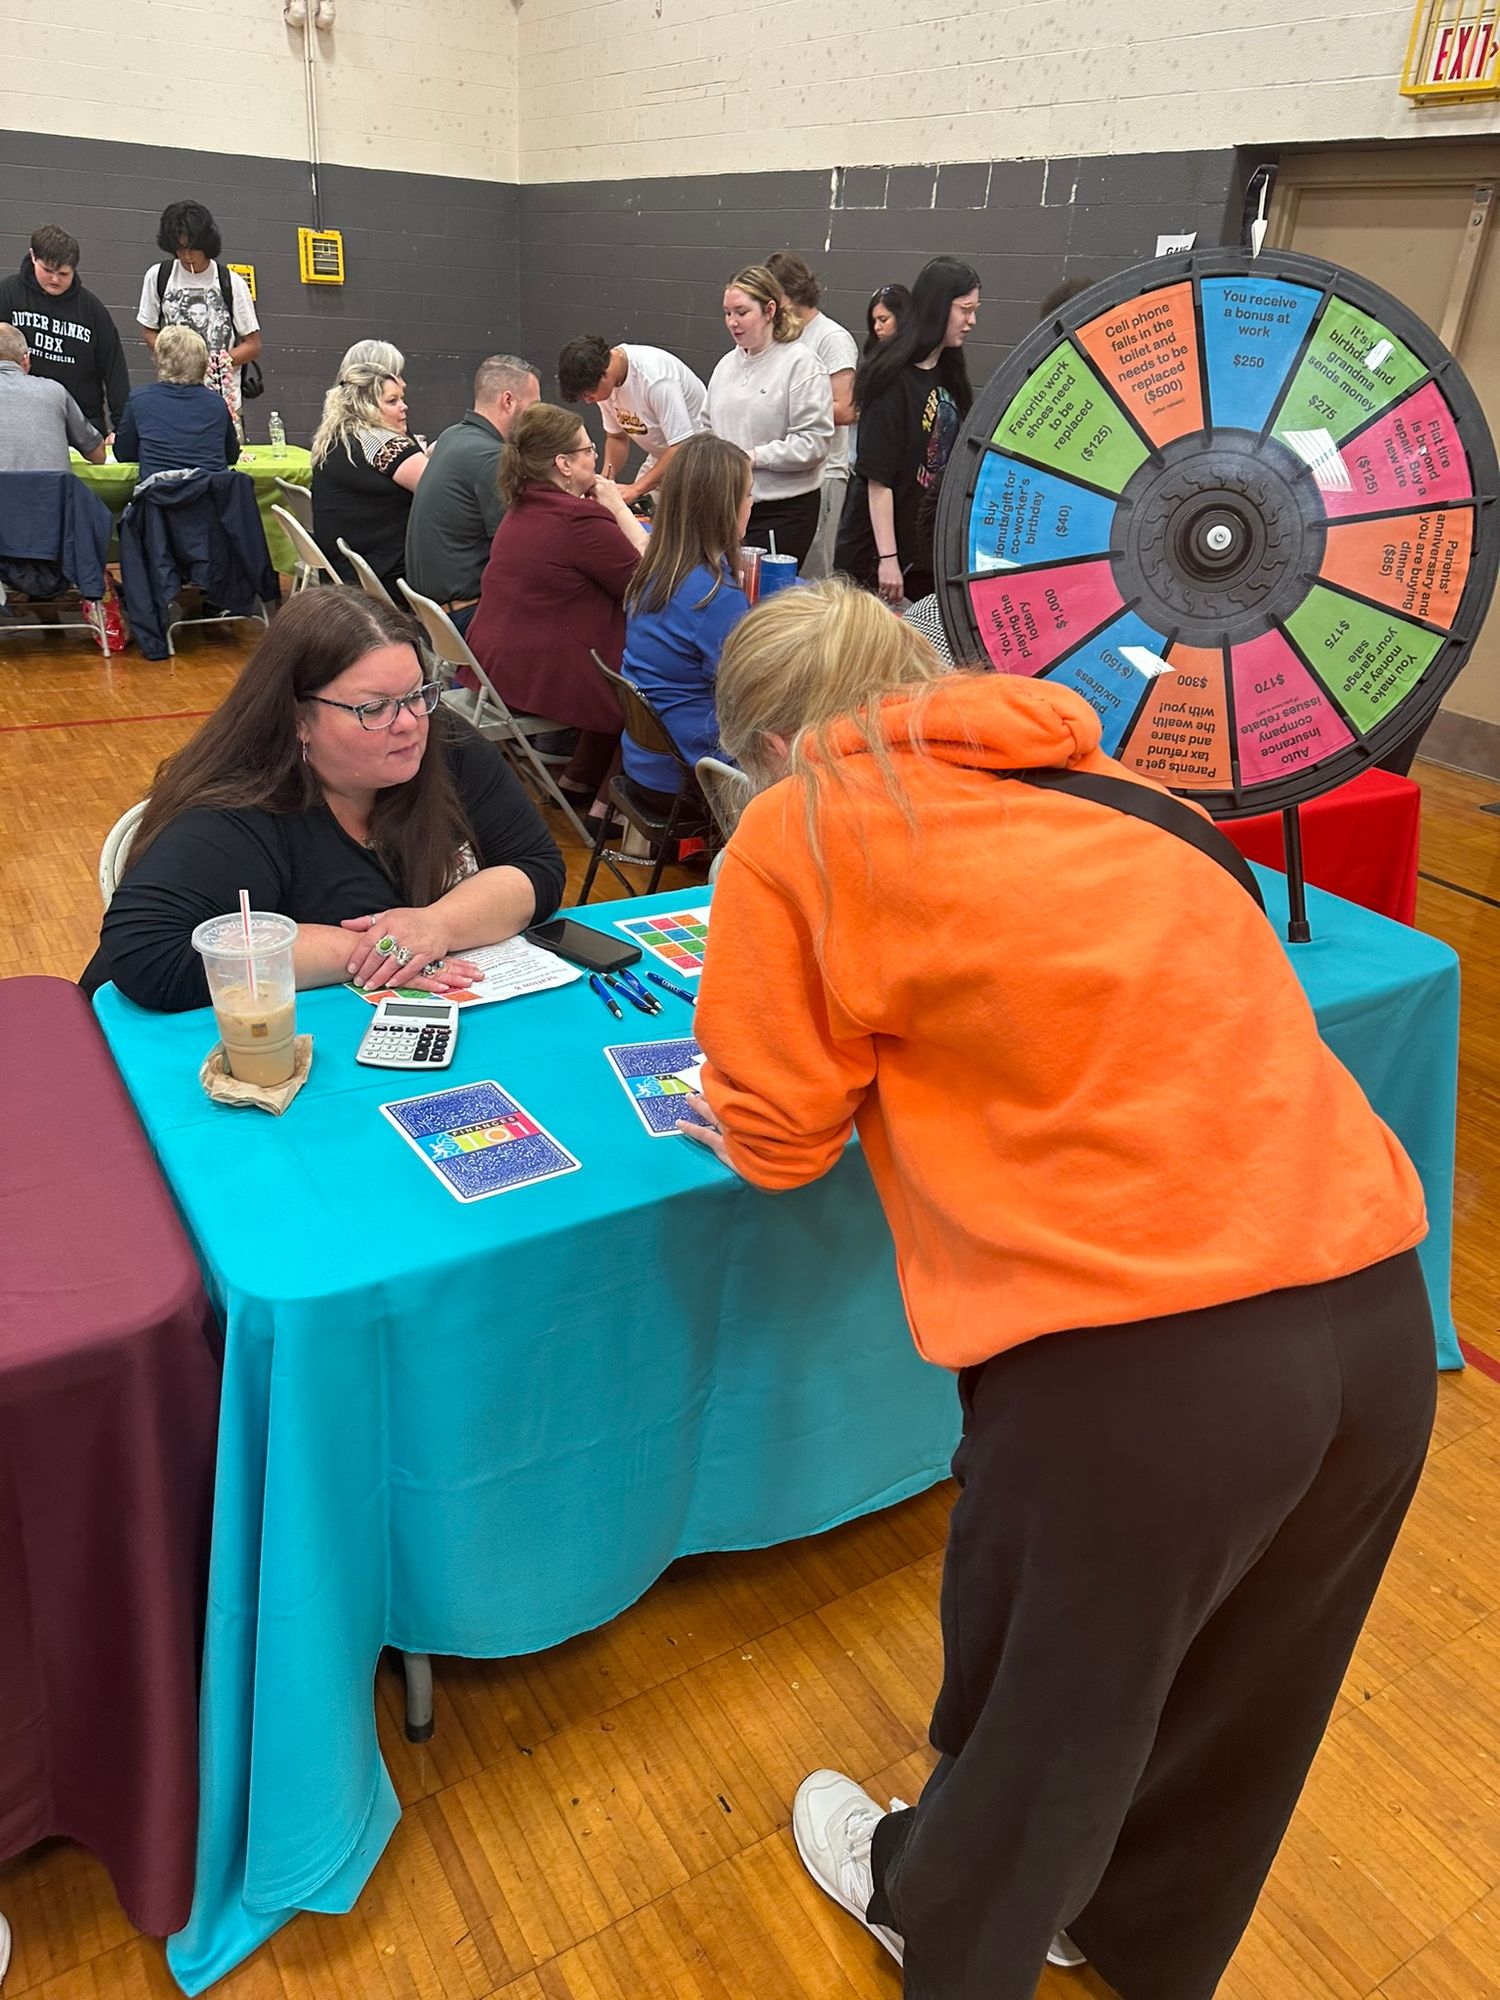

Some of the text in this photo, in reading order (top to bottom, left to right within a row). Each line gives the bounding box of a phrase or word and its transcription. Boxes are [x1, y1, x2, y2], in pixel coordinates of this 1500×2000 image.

[1433, 23, 1493, 81] EXIT
[1223, 290, 1296, 308] You receive
[1105, 304, 1170, 338] Cell phone
[1224, 308, 1290, 324] a bonus at
[1239, 326, 1270, 337] work
[35, 332, 63, 353] OBX
[1111, 318, 1174, 352] falls in the
[1119, 332, 1176, 365] toilet and
[1350, 325, 1394, 364] It's yr
[28, 347, 75, 363] ORTH CAROLINA
[1118, 345, 1188, 382] needs to be
[1233, 354, 1264, 368] $250
[1326, 352, 1375, 391] grandma
[1132, 361, 1185, 392] replaced
[1308, 356, 1376, 412] sends money
[1372, 365, 1396, 385] and
[1008, 361, 1069, 435] Favorite work
[1026, 375, 1076, 438] shoes need
[1144, 379, 1183, 405] ($500)
[1308, 395, 1338, 420] $275
[1049, 402, 1074, 431] to be
[1053, 399, 1094, 450] replaced
[1081, 425, 1112, 461] ($125)
[1428, 420, 1450, 468] Flat tire
[1355, 455, 1379, 495] ($125)
[1384, 438, 1407, 488] new tire
[1409, 461, 1423, 485] Buy
[1418, 487, 1427, 496] a
[984, 501, 999, 525] Buy
[994, 470, 1017, 558] donuts/gift for
[1011, 478, 1030, 554] co-worker's
[1025, 491, 1045, 544] birthday
[1055, 505, 1073, 537] ($40)
[1379, 544, 1397, 576] ($85)
[1396, 541, 1411, 582] dinner
[1402, 516, 1430, 610] you are buying
[1419, 514, 1446, 616] anniversary and
[1019, 602, 1039, 641] lottery
[1044, 588, 1068, 629] $1,000
[991, 609, 1013, 657] You win
[1001, 594, 1033, 658] playing the
[1324, 620, 1350, 649] $175
[1100, 649, 1135, 679] ($150)
[1343, 626, 1398, 692] your garage
[1348, 640, 1370, 663] sale
[1177, 675, 1208, 689] $300
[1254, 672, 1285, 694] $170
[1360, 645, 1402, 694] money at
[1370, 654, 1418, 704] You make
[1074, 668, 1122, 709] tux/dress
[1153, 716, 1216, 734] the wealth
[1159, 702, 1214, 718] with you!
[1241, 696, 1322, 734] issues rebate
[1151, 731, 1212, 746] and share
[1259, 715, 1313, 742] company
[1261, 727, 1321, 757] insurance
[1136, 758, 1216, 778] Parents get a
[1147, 745, 1209, 762] tax refund
[1281, 747, 1309, 764] Auto
[451, 1116, 517, 1136] FINANCES
[465, 1122, 530, 1151] 101
